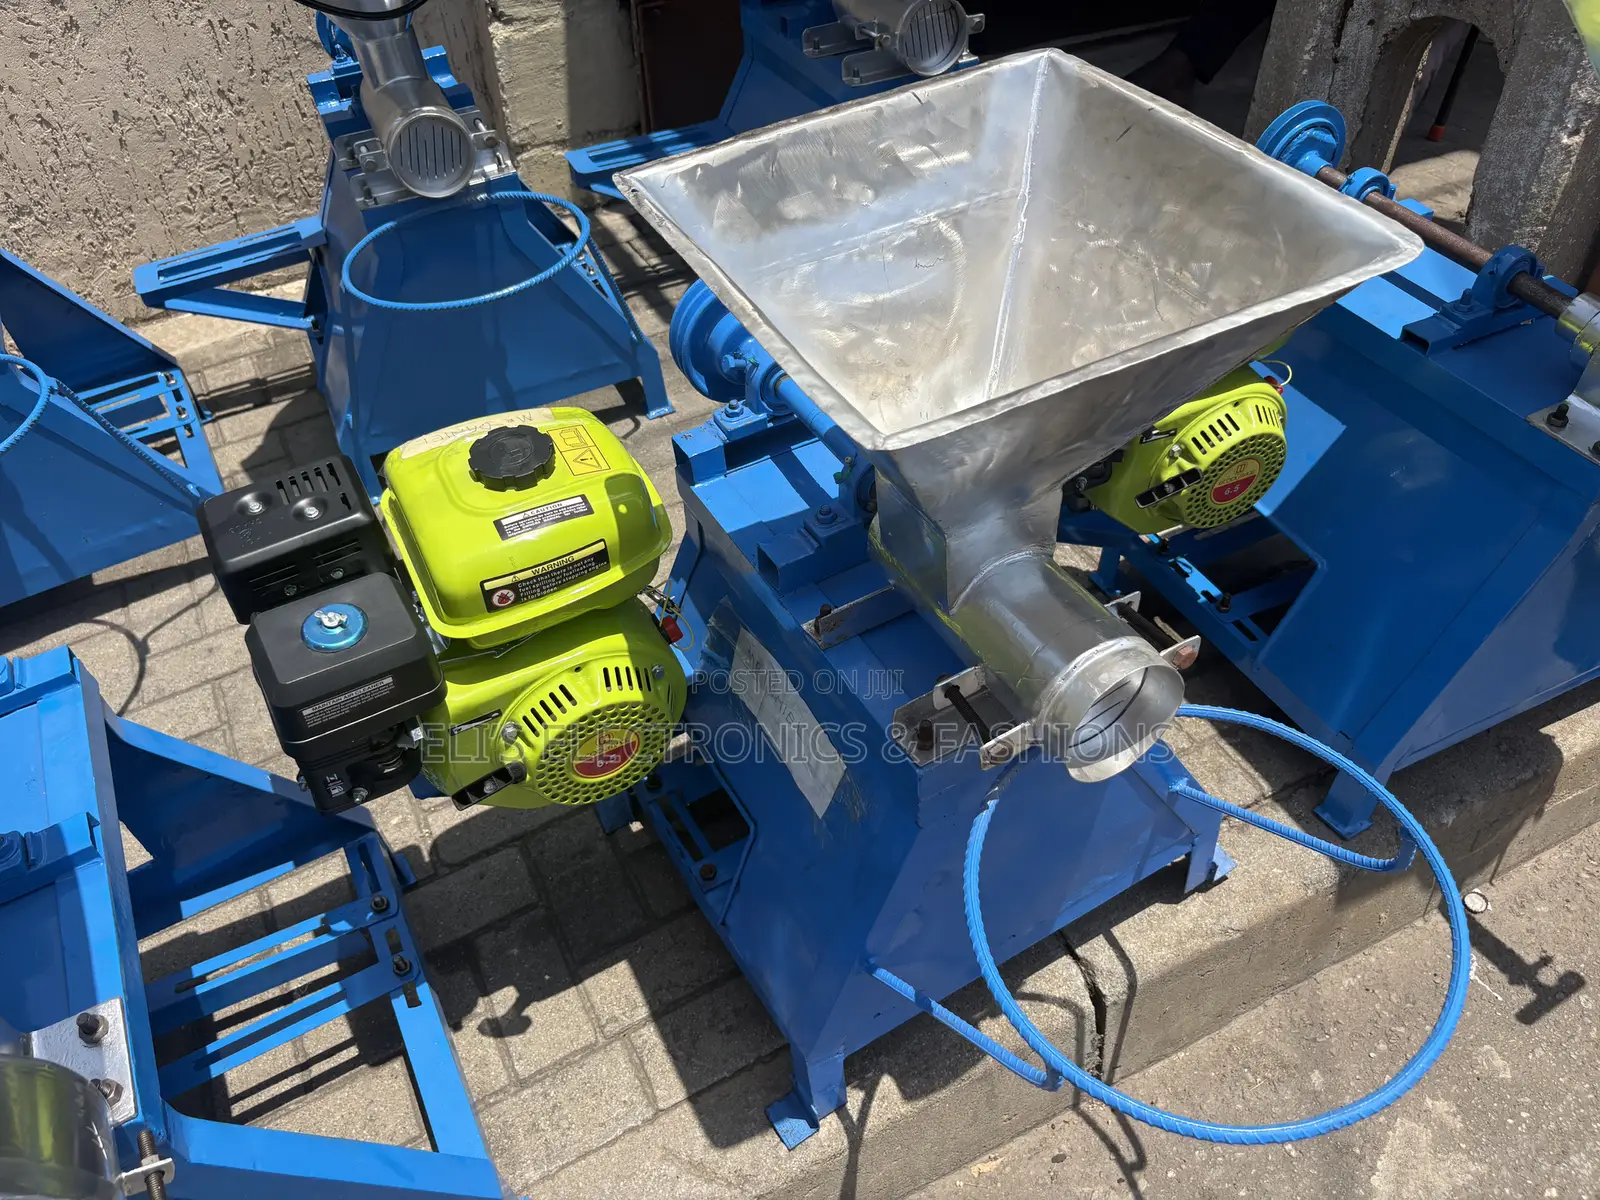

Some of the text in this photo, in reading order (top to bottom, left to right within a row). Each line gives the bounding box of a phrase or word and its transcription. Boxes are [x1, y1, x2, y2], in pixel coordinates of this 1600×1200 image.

[1224, 484, 1241, 495] 6.5
[530, 502, 563, 515] CAUTION
[531, 555, 575, 576] WARNING
[543, 579, 561, 590] before
[562, 569, 588, 583] stopping
[588, 561, 607, 572] engine
[518, 578, 537, 588] Check
[537, 573, 550, 582] that
[551, 568, 566, 577] there
[532, 577, 556, 589] spilling
[312, 681, 385, 711] MAINTAIN AIR CLEANER
